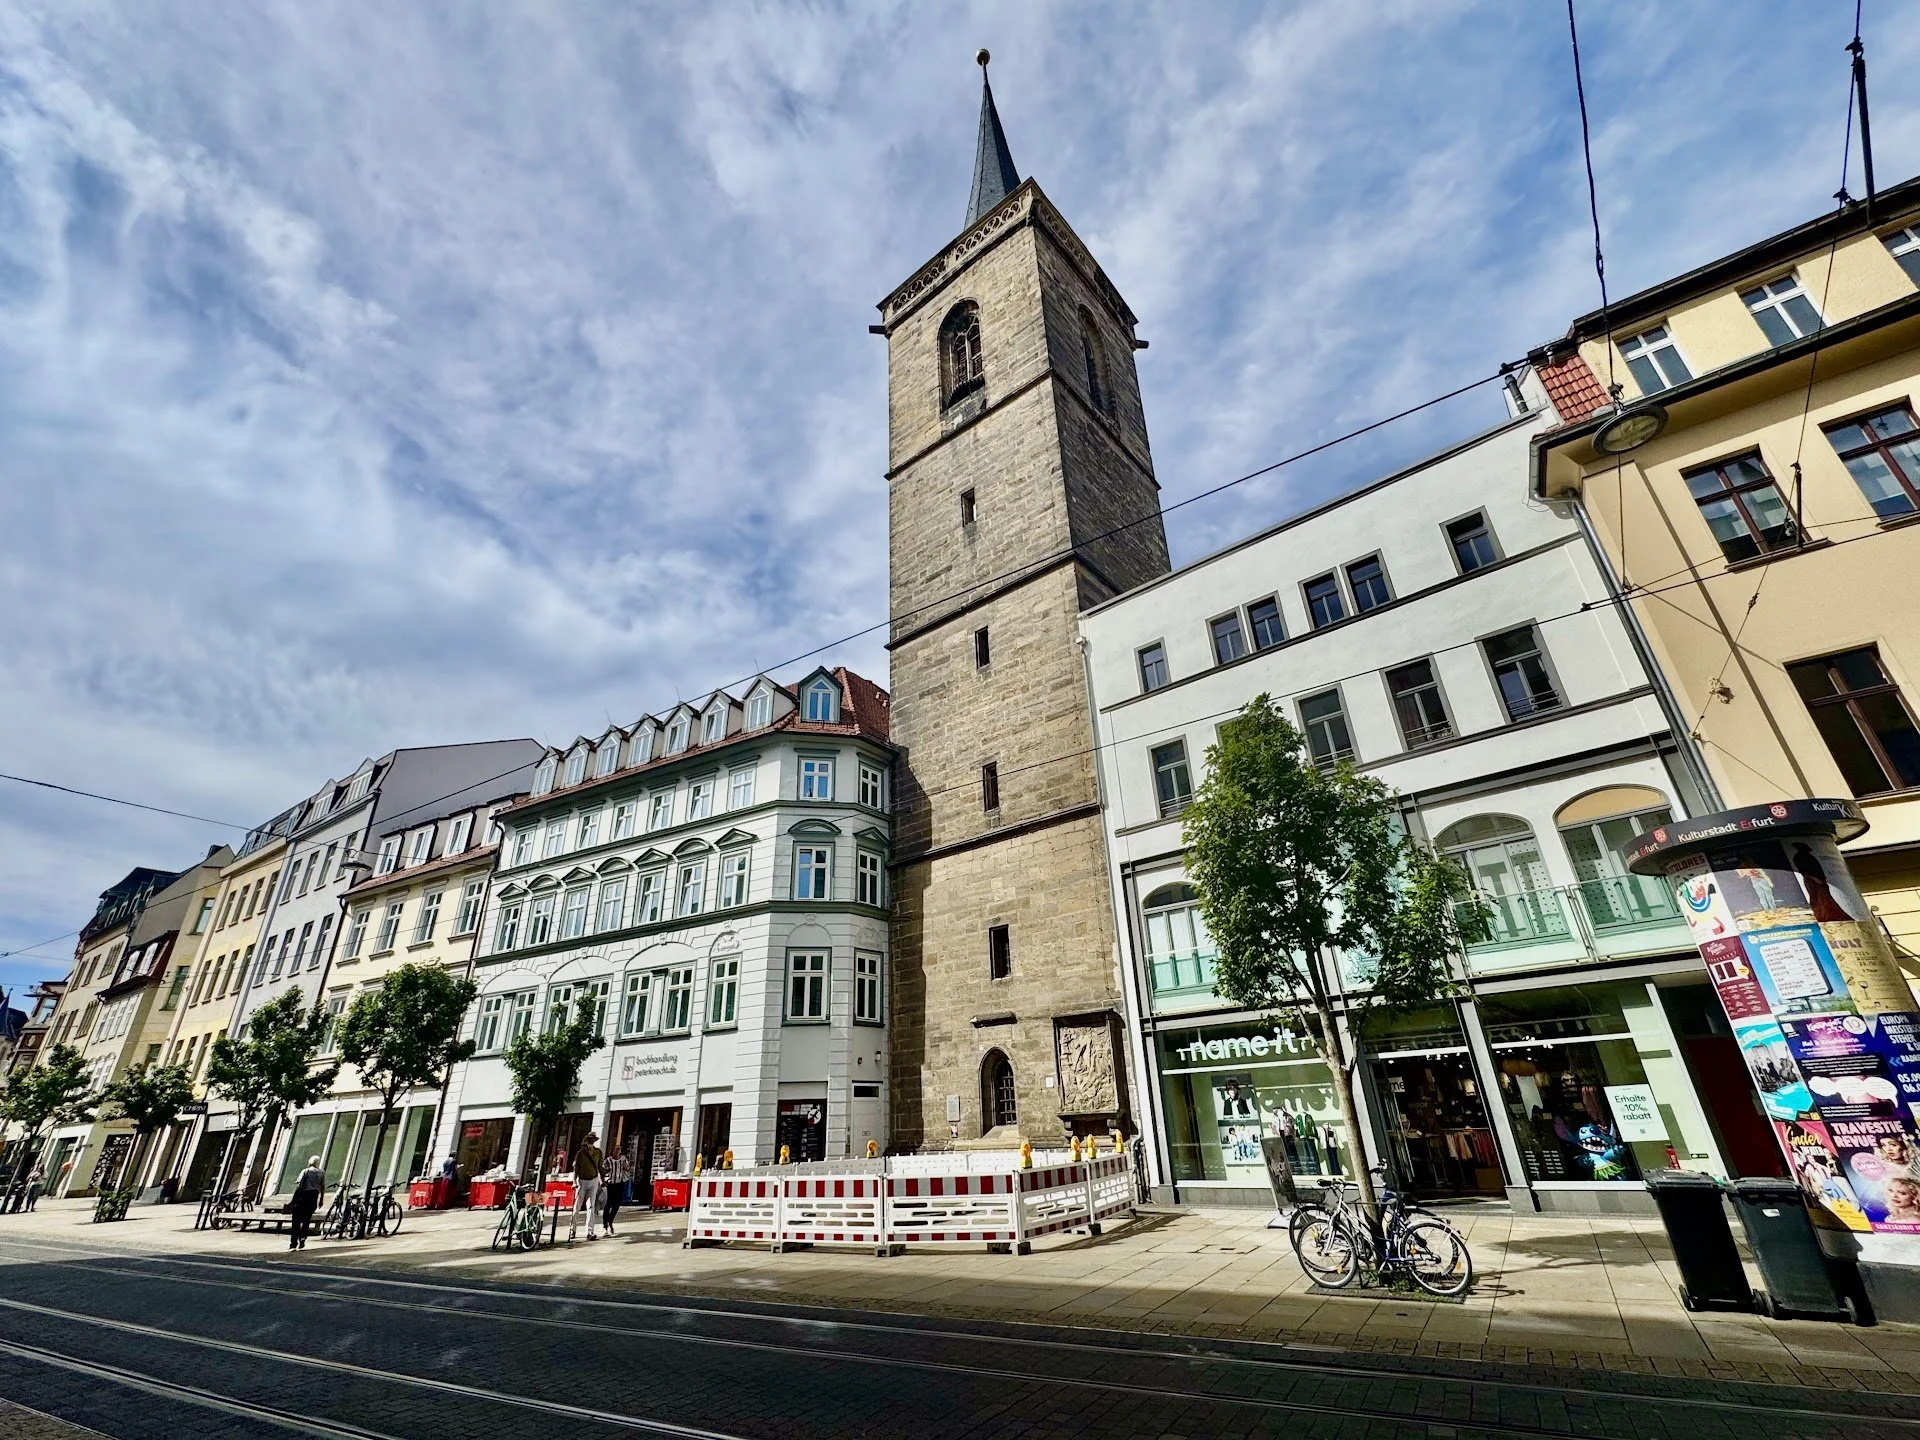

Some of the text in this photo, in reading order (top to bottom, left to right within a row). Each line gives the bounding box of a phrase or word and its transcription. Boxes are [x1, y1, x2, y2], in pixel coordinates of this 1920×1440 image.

[1677, 816, 1775, 843] Kulturstadt Erfurt
[1639, 843, 1660, 856] Erfurt
[1879, 1015, 1910, 1025] EUROPA
[1190, 1026, 1299, 1062] name it
[1614, 1094, 1647, 1103] Erhalte
[1624, 1103, 1643, 1112] 10%
[1623, 1112, 1652, 1121] rabatt
[1829, 1120, 1906, 1135] TRAVESTIE
[1783, 1126, 1823, 1147] Kinder
[1832, 1135, 1879, 1149] REVUE
